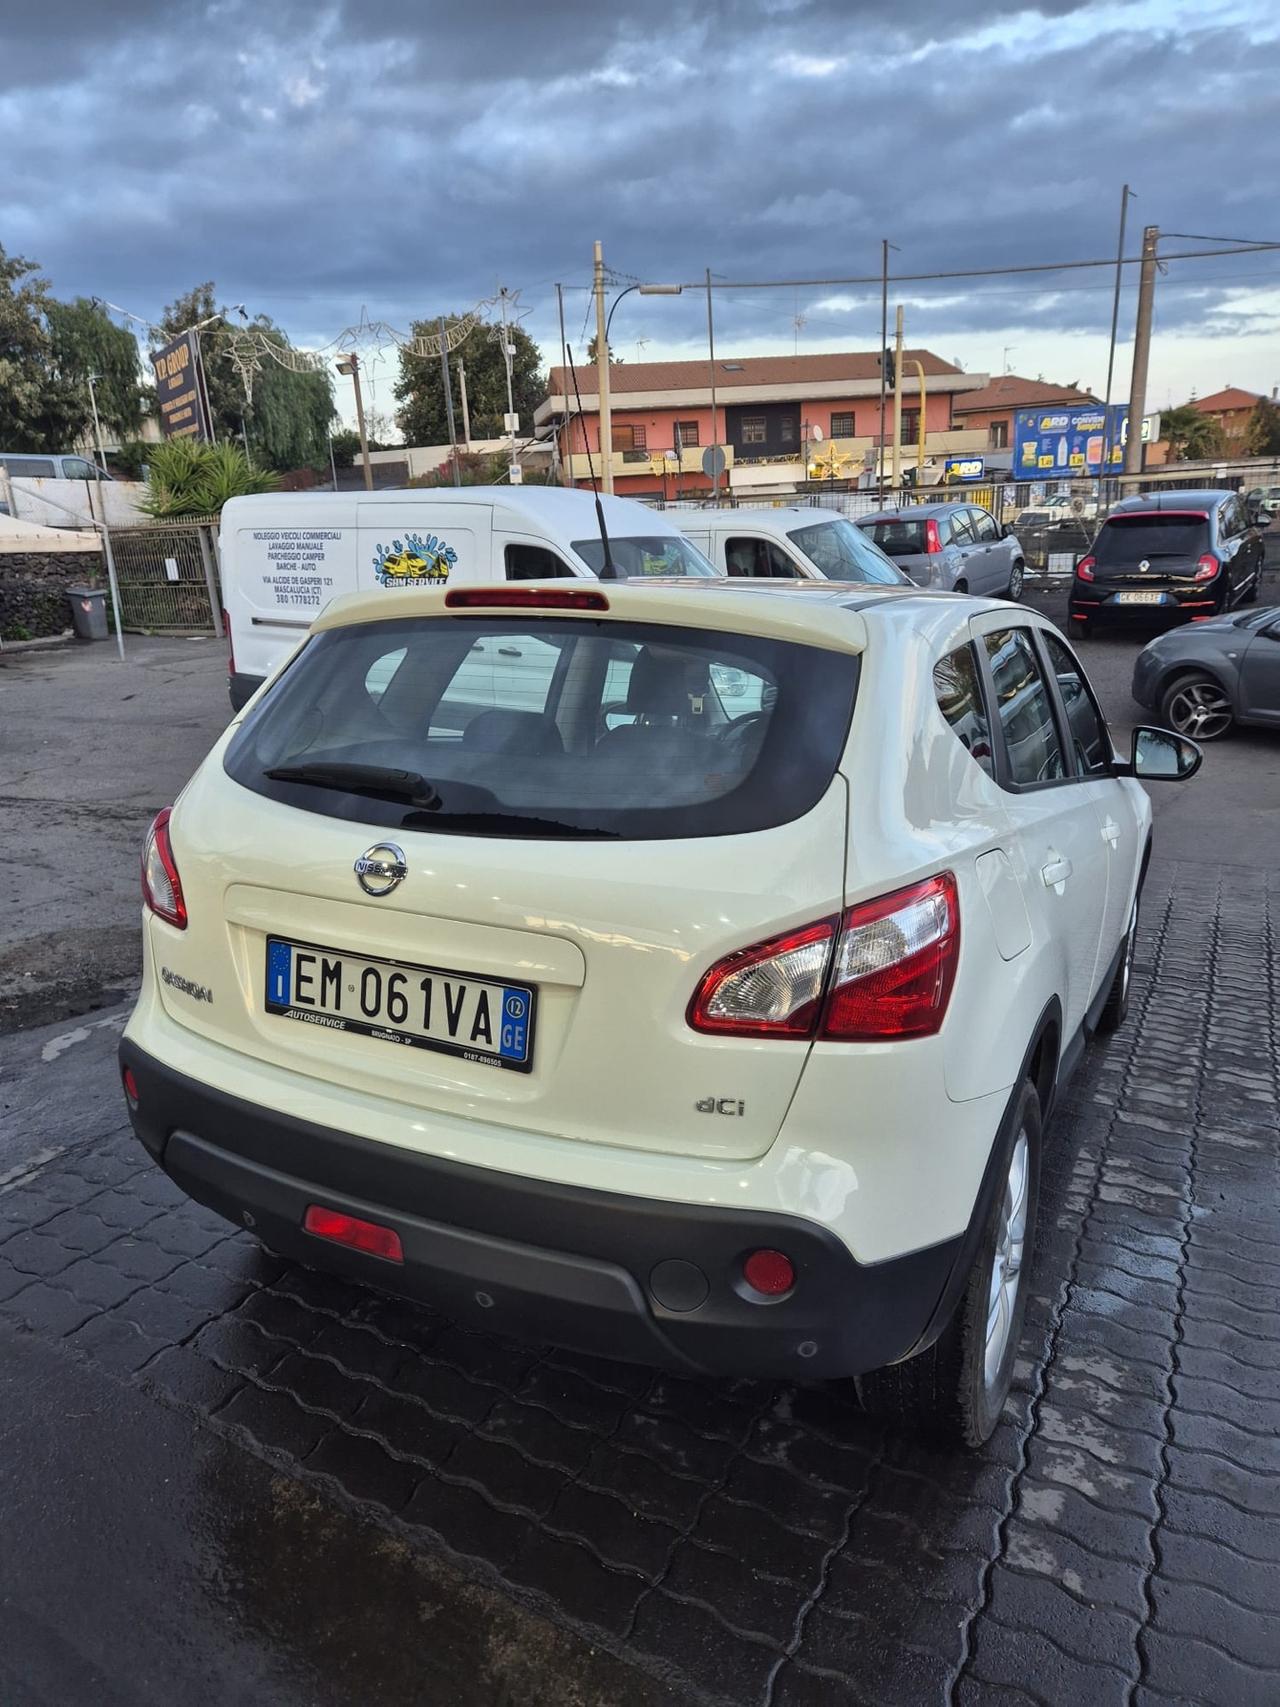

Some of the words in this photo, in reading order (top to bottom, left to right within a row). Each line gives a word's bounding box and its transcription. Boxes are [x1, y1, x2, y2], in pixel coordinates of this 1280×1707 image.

[166, 343, 189, 376] GROUP
[1040, 417, 1069, 429] ARD
[253, 532, 280, 540] NOLEGGIO
[281, 532, 301, 540] VEICOLI
[302, 532, 341, 540] COMMERCIALI
[268, 542, 295, 550] LAVAGGIO
[296, 542, 324, 550] MANUALE
[267, 552, 301, 560] PARCHEGGIO
[302, 552, 325, 560] CAMPER
[276, 562, 297, 570] BARCHE
[301, 563, 316, 571] AUTO
[262, 576, 271, 584] VIA
[272, 576, 290, 584] ALCIDE
[291, 576, 299, 584] DE
[300, 577, 322, 585] GASPERI
[323, 577, 333, 586] 121
[274, 586, 310, 594] MASCALUCIA
[311, 587, 322, 595] (CT)
[276, 594, 289, 604] 380
[290, 595, 320, 605] 1778272
[161, 966, 213, 1004] QASHQAI
[295, 953, 342, 1011] EM
[360, 966, 493, 1046] 061VA
[509, 1000, 522, 1010] 12
[283, 1009, 346, 1031] AUTOSERVICE
[371, 1030, 400, 1043] BRUGNATO
[404, 1037, 412, 1045] SP
[502, 1023, 524, 1052] GE
[695, 1096, 745, 1117] dCi
